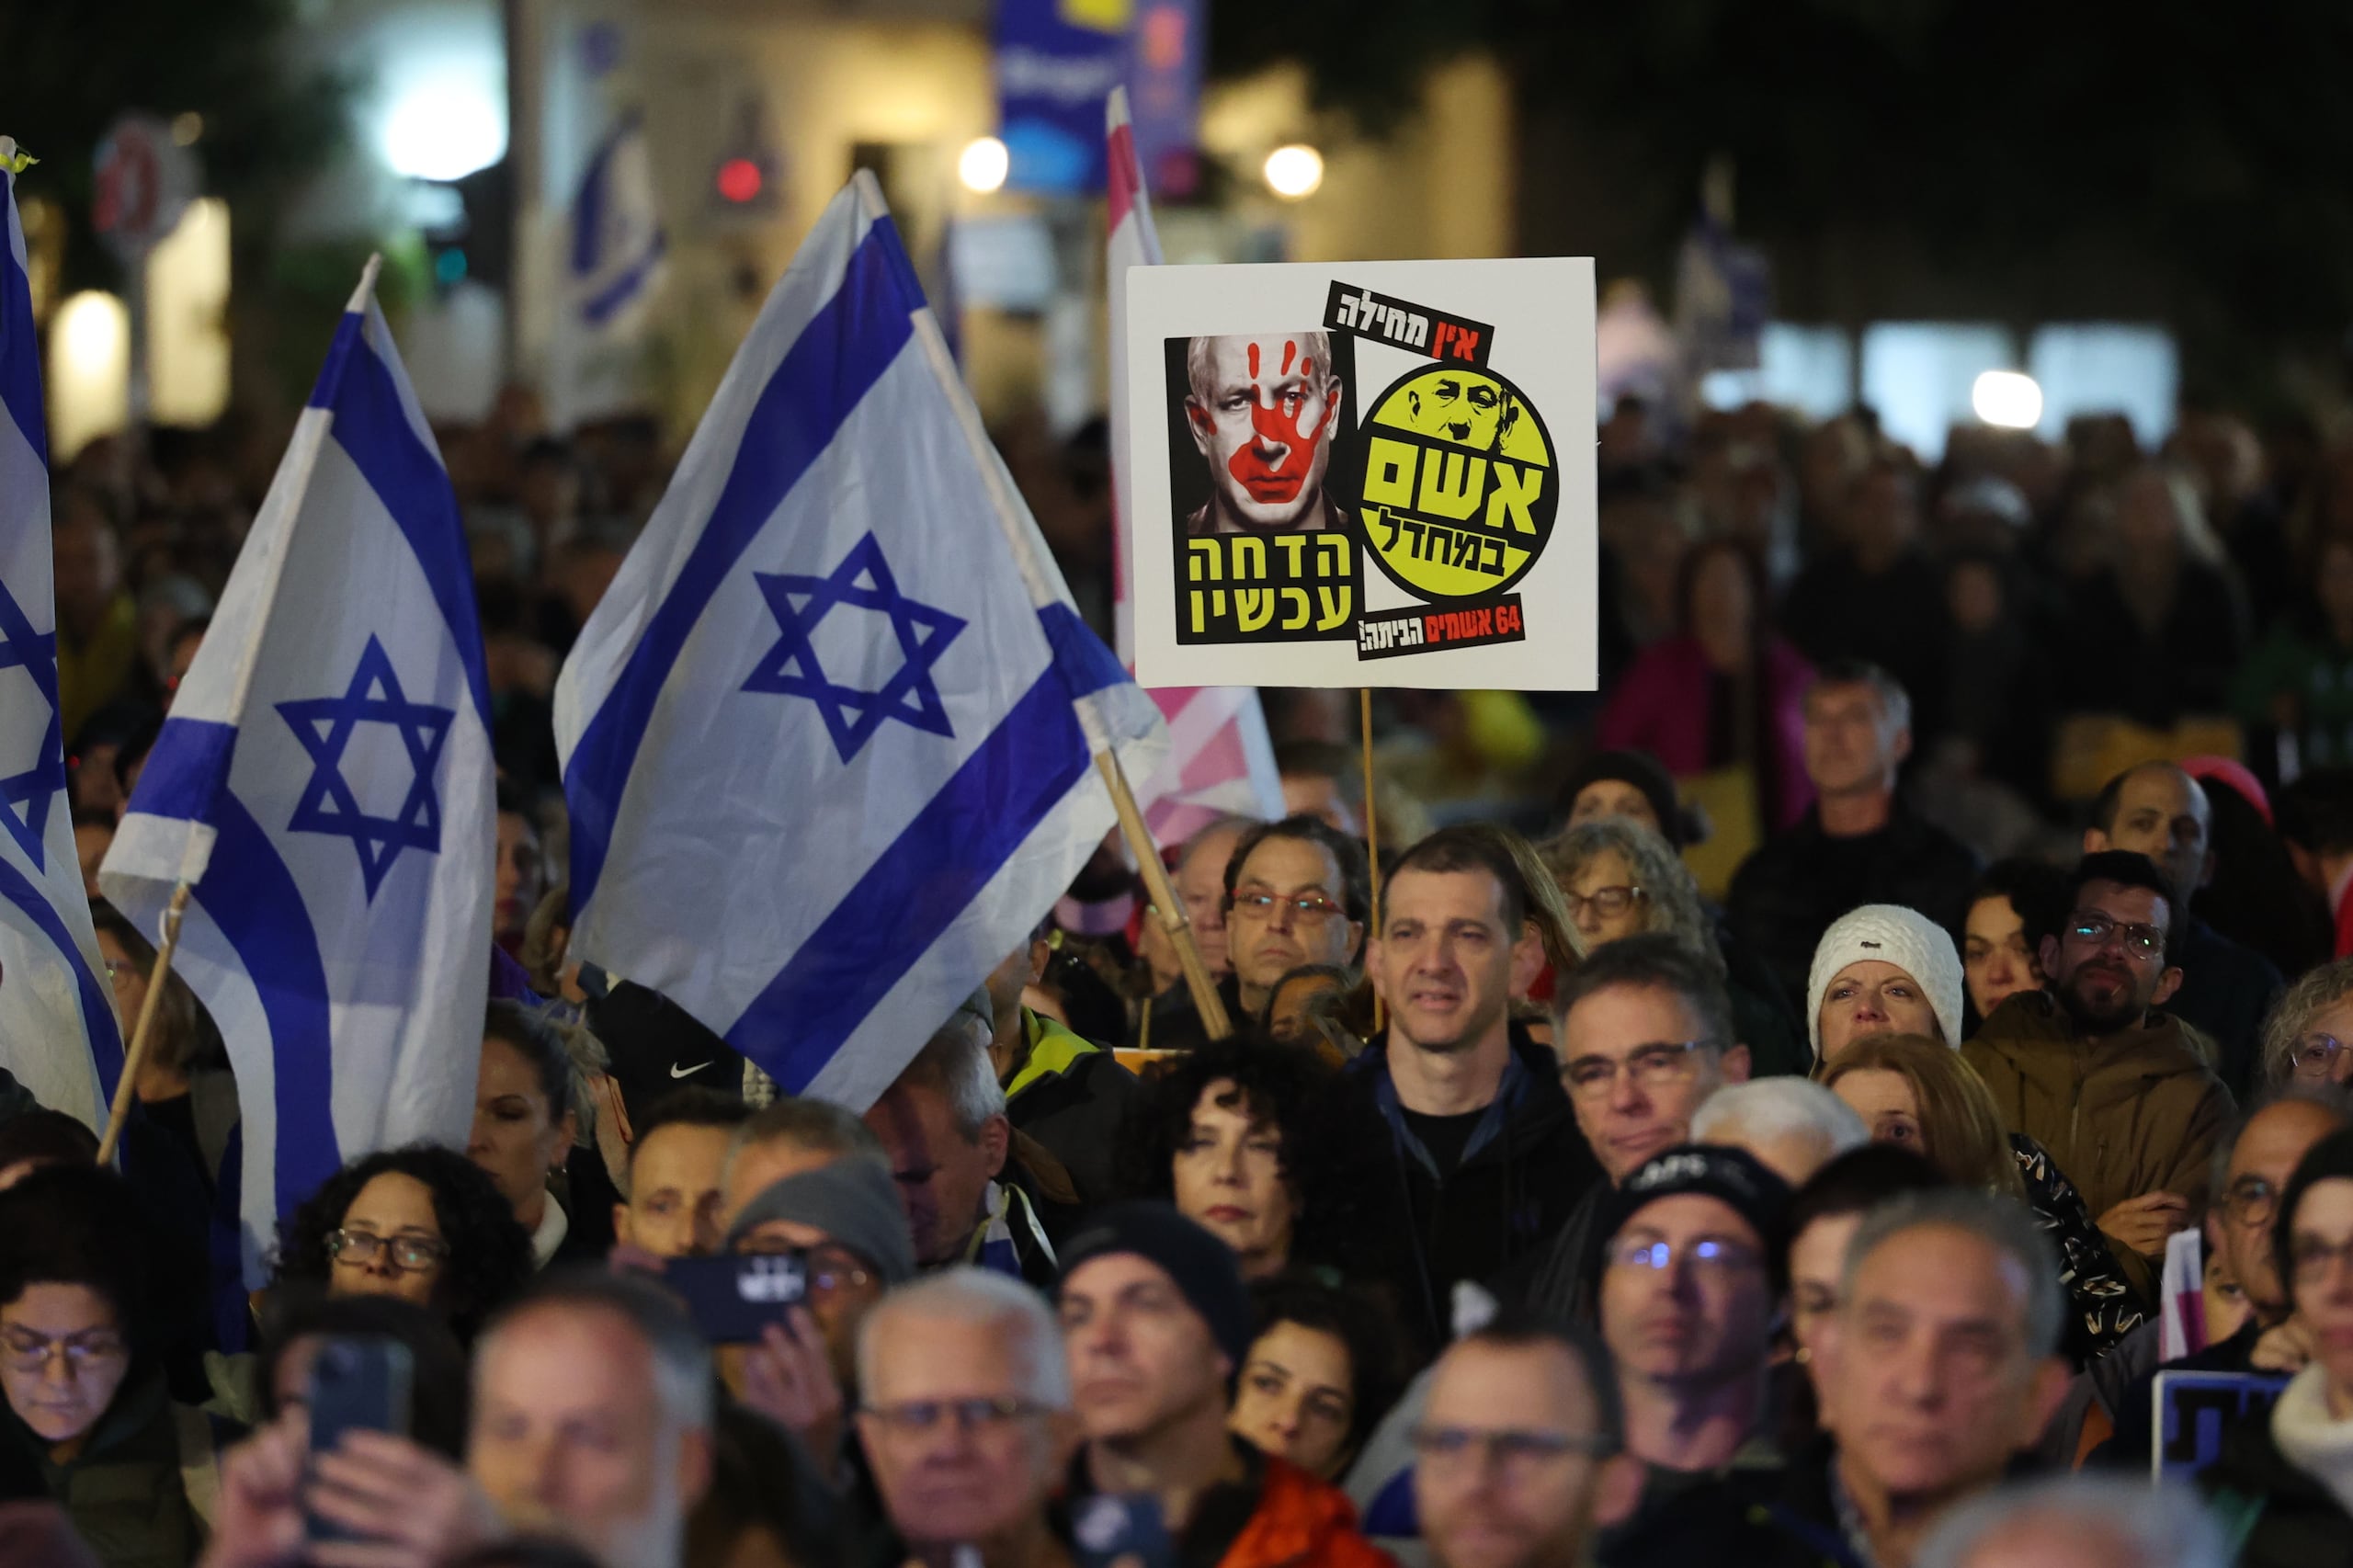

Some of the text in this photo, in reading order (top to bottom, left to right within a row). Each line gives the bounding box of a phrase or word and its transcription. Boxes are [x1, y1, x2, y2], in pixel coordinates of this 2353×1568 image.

[1336, 290, 1480, 362] אין מחילה
[1362, 436, 1544, 536] אשם
[1188, 533, 1351, 582] הדחה
[1379, 506, 1506, 577] במחדל
[1189, 585, 1352, 633] עכשיו
[1358, 605, 1521, 652] 64 אשמים הביתה!
